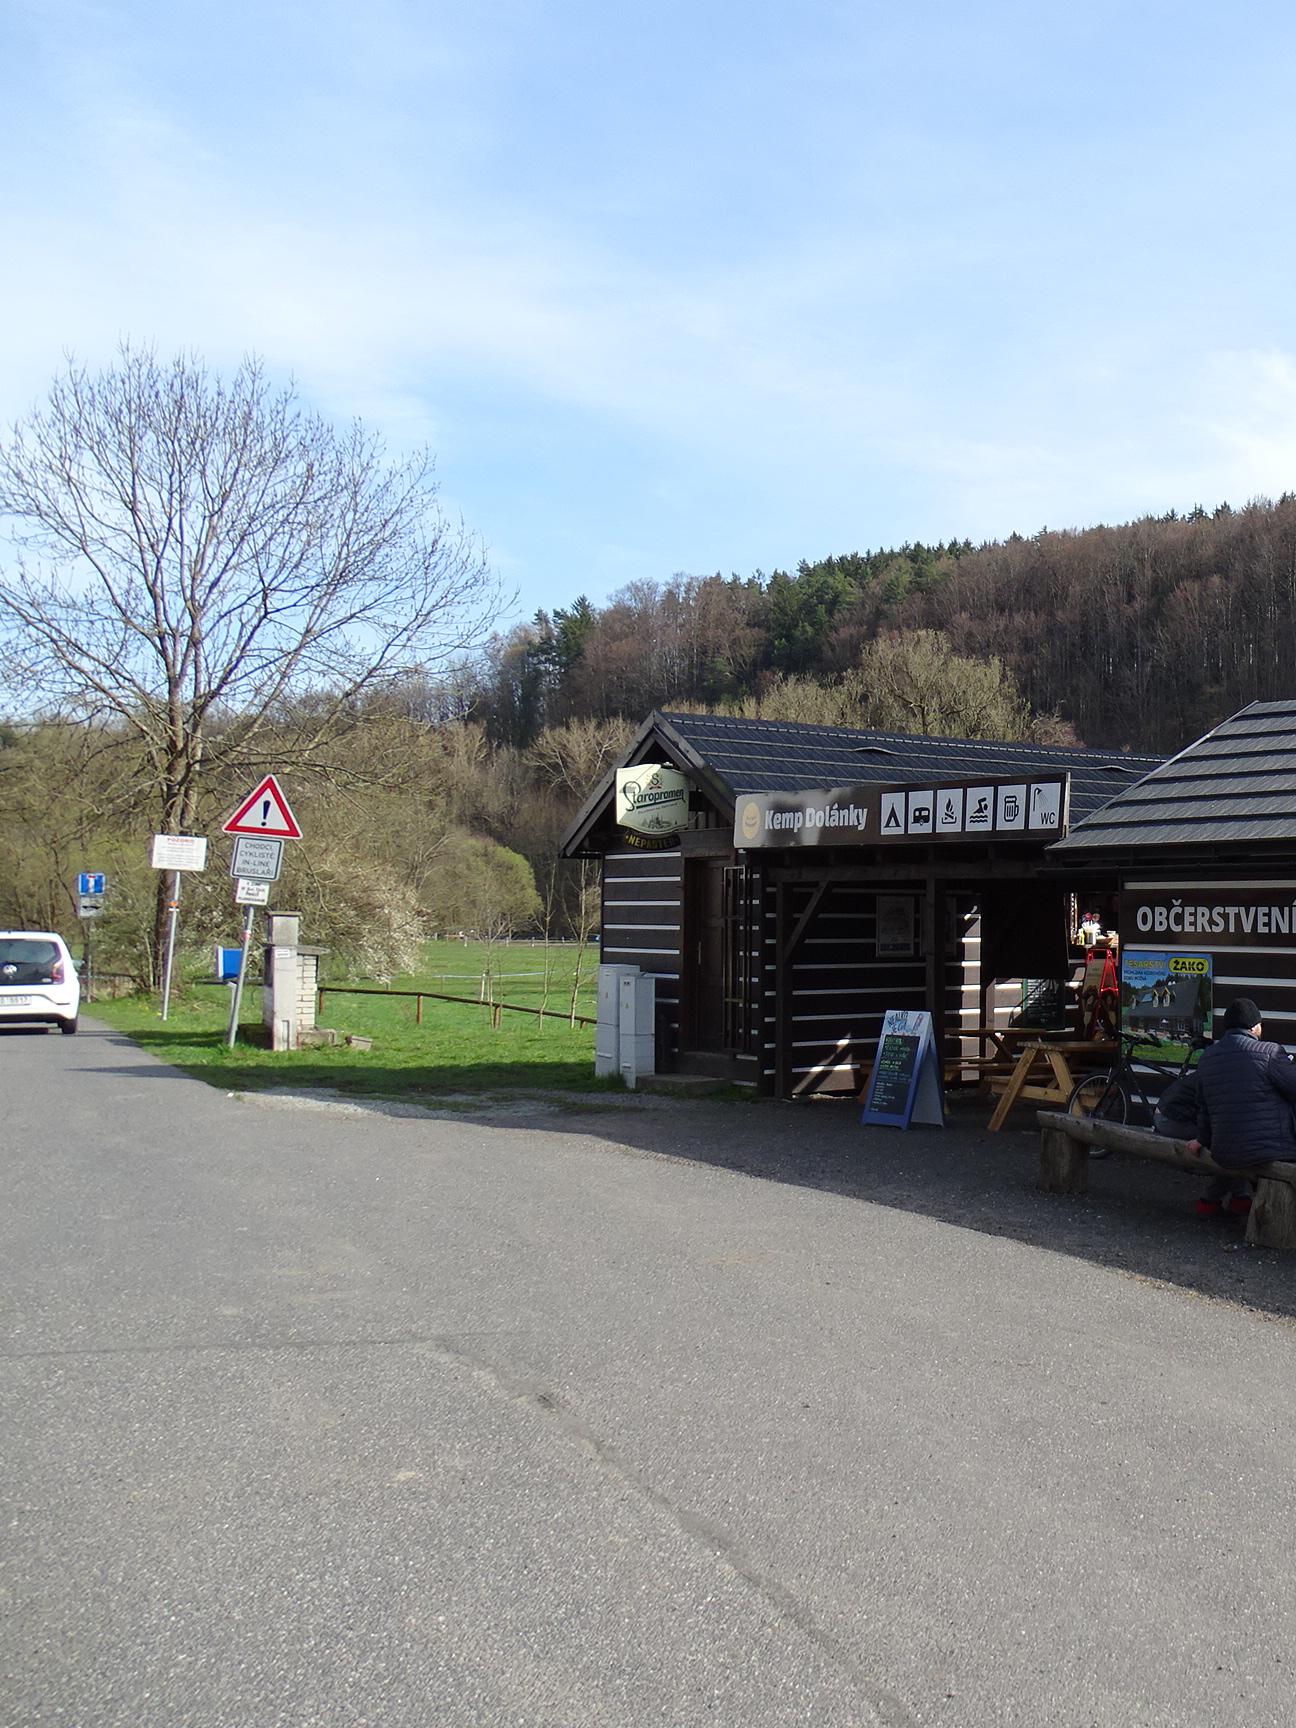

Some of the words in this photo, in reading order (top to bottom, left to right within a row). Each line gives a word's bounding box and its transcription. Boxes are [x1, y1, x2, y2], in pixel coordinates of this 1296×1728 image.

[622, 781, 686, 812] Staropramen
[765, 809, 801, 833] Kemp
[805, 803, 868, 831] Dolánky
[1041, 811, 1056, 825] WC
[242, 859, 270, 867] IN-LINE
[236, 867, 273, 876] BRUSLAŘI
[1173, 959, 1205, 972] ŽAKO
